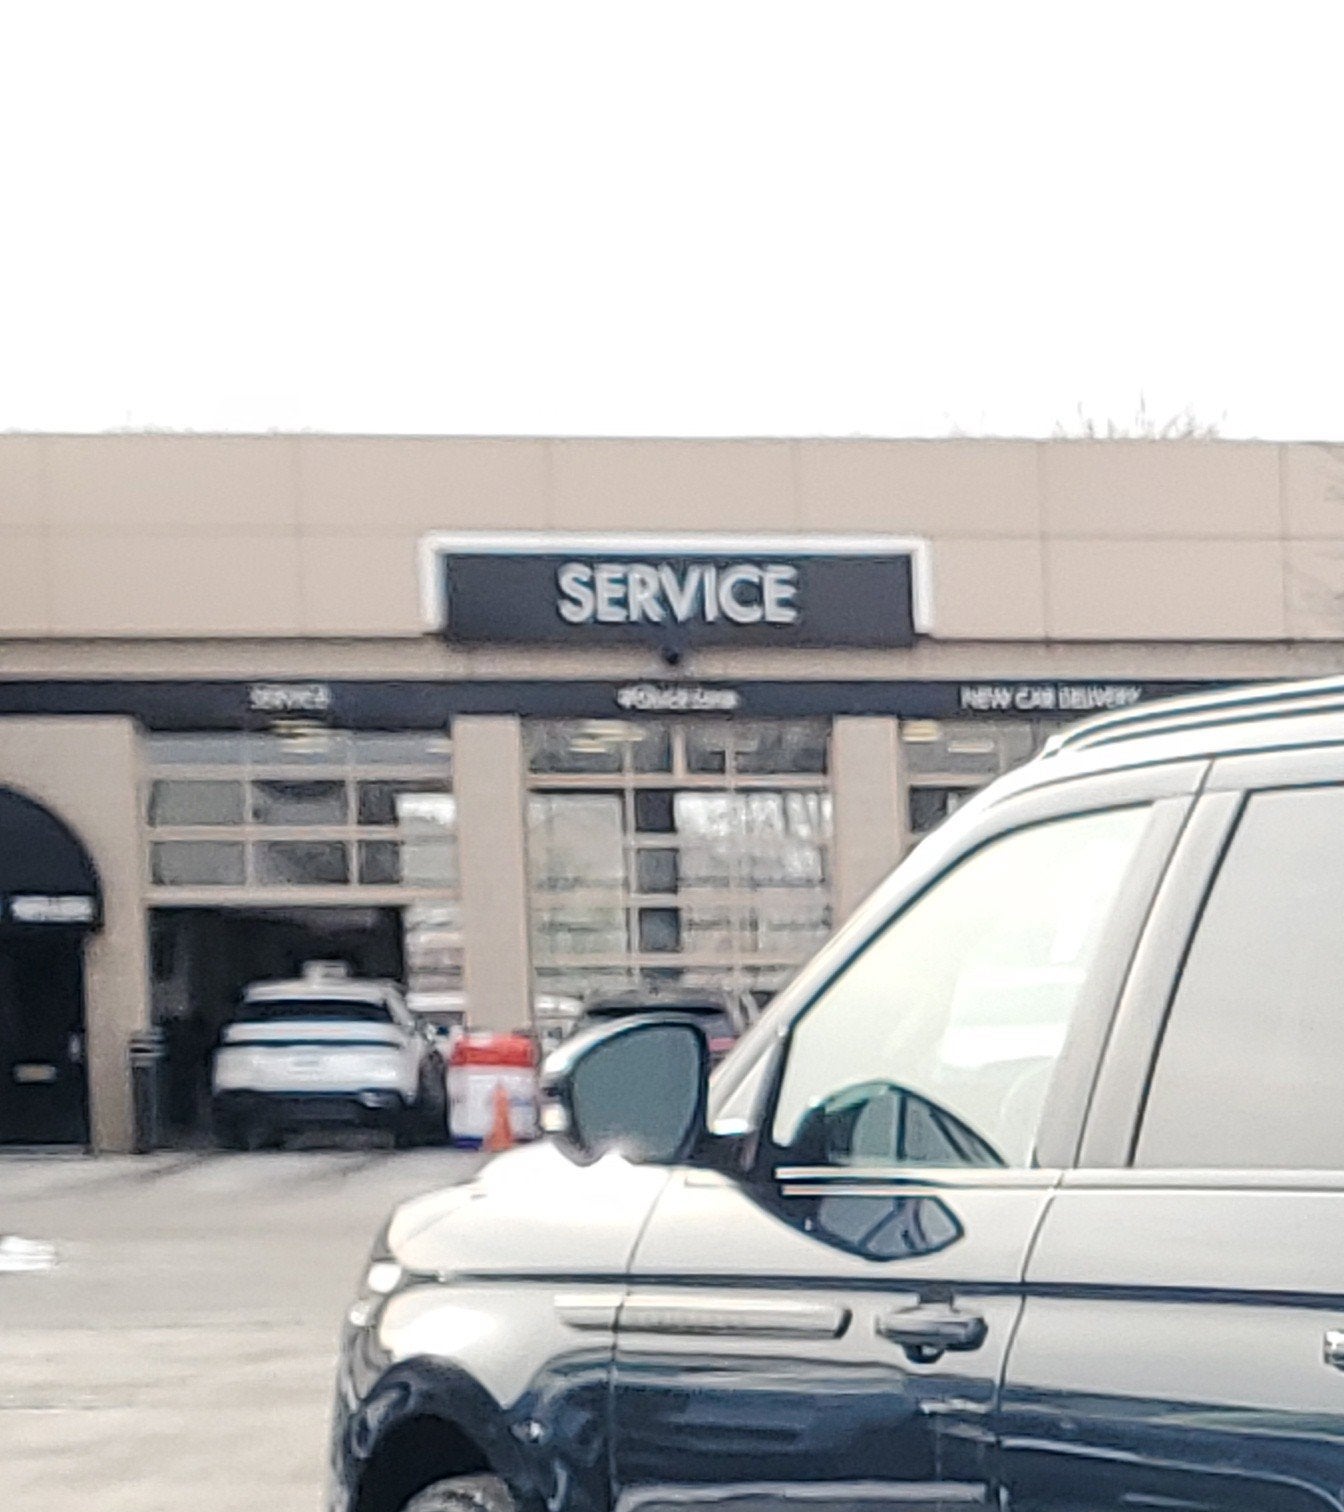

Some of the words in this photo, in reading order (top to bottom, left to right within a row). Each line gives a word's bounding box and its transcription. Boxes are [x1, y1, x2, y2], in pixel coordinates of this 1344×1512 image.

[557, 562, 799, 624] SERVICE
[960, 685, 1012, 710] NEW
[1015, 686, 1055, 710] CAR
